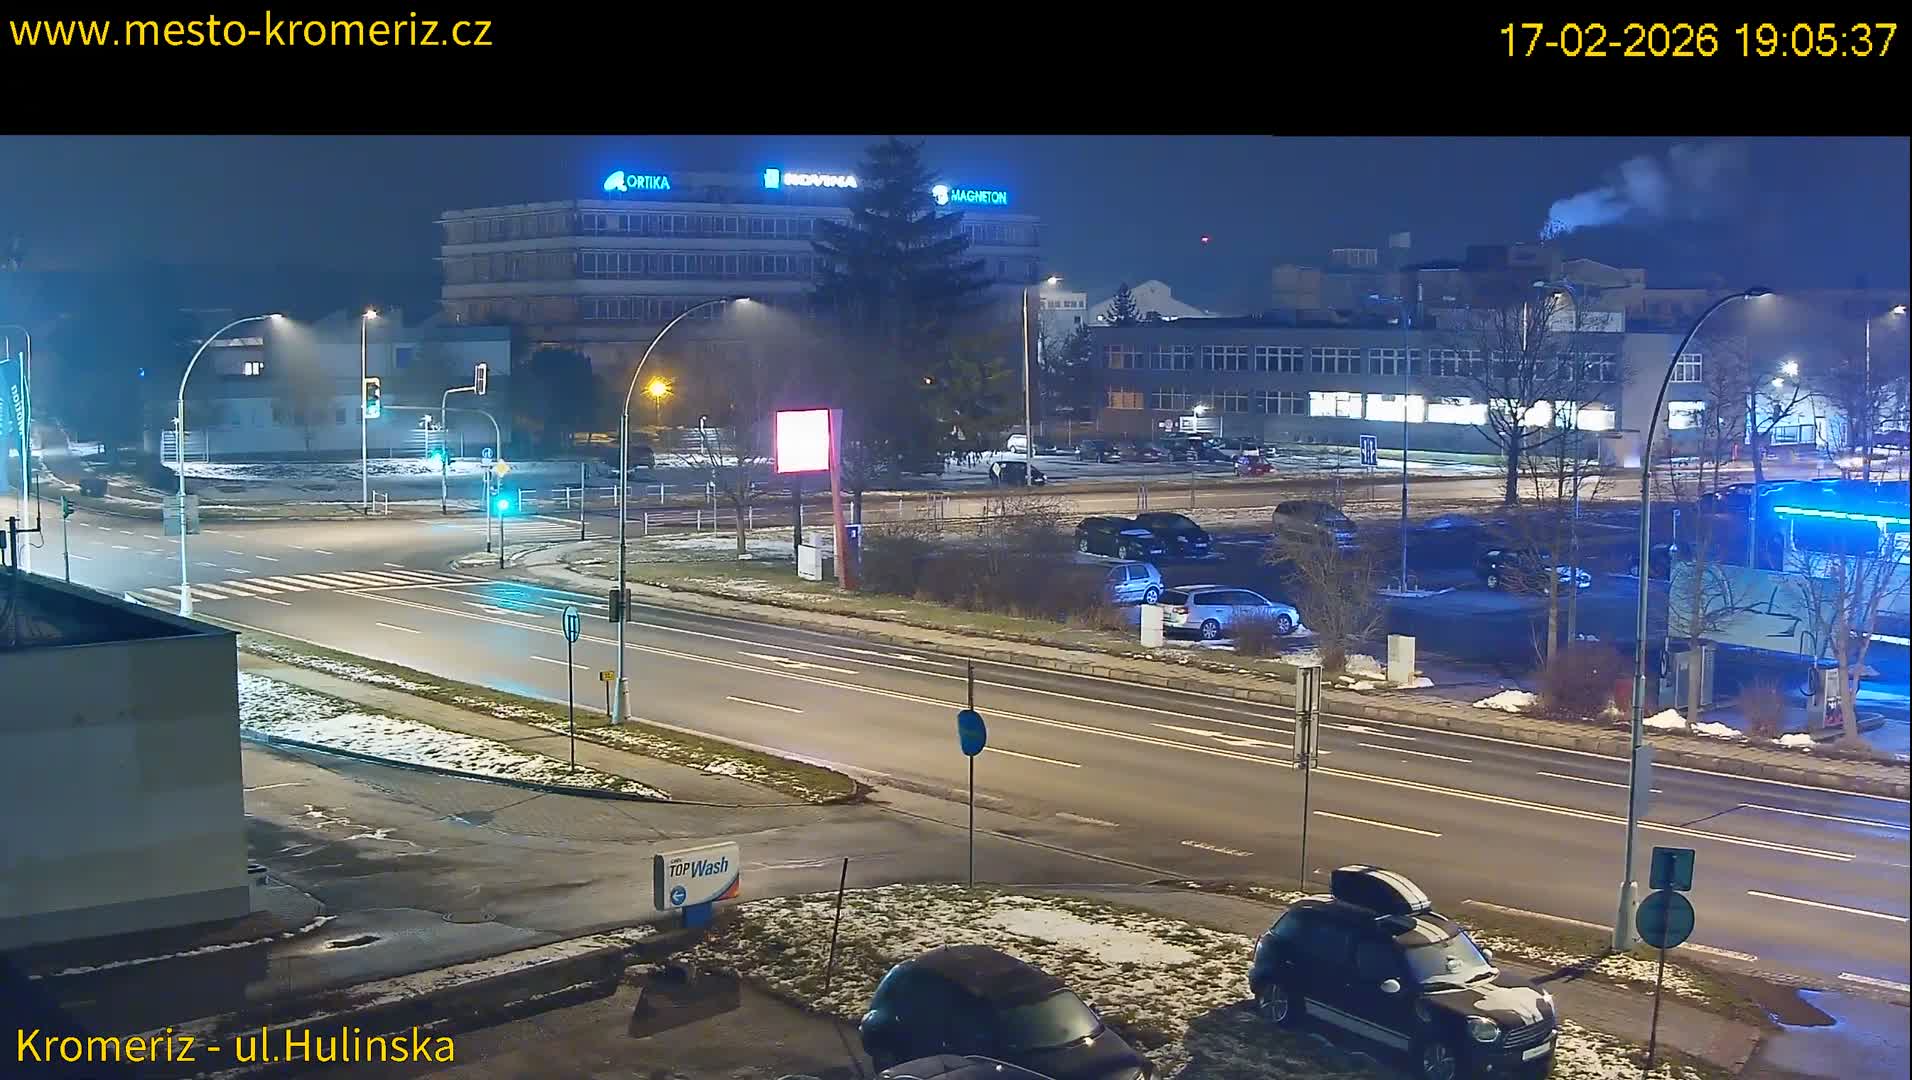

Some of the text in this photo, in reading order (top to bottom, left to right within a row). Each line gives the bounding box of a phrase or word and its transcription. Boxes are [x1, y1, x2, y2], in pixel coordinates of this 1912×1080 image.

[627, 174, 671, 190] ORTIKA
[951, 189, 1008, 205] MAGNETON
[670, 856, 729, 878] TOP Wash
